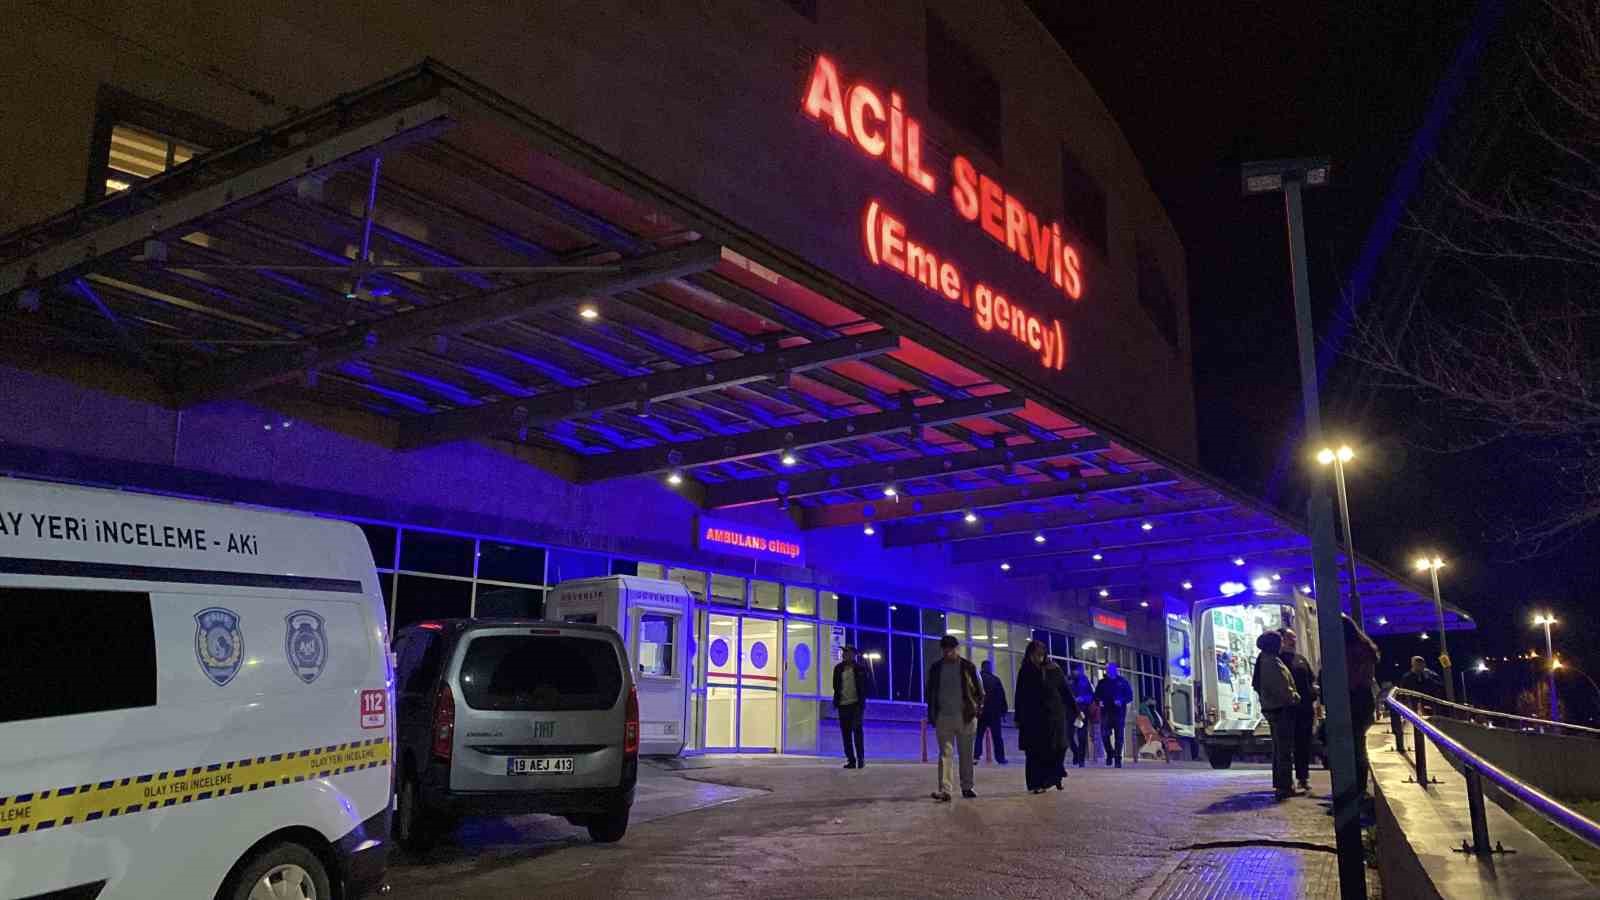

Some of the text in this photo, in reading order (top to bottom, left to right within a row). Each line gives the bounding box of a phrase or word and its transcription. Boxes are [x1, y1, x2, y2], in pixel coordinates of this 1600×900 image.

[953, 155, 1082, 300] SERVİS
[706, 528, 767, 551] AMBULANS
[365, 693, 384, 711] 112
[534, 721, 556, 737] FIAT
[515, 759, 572, 770] 19 AEJ 413
